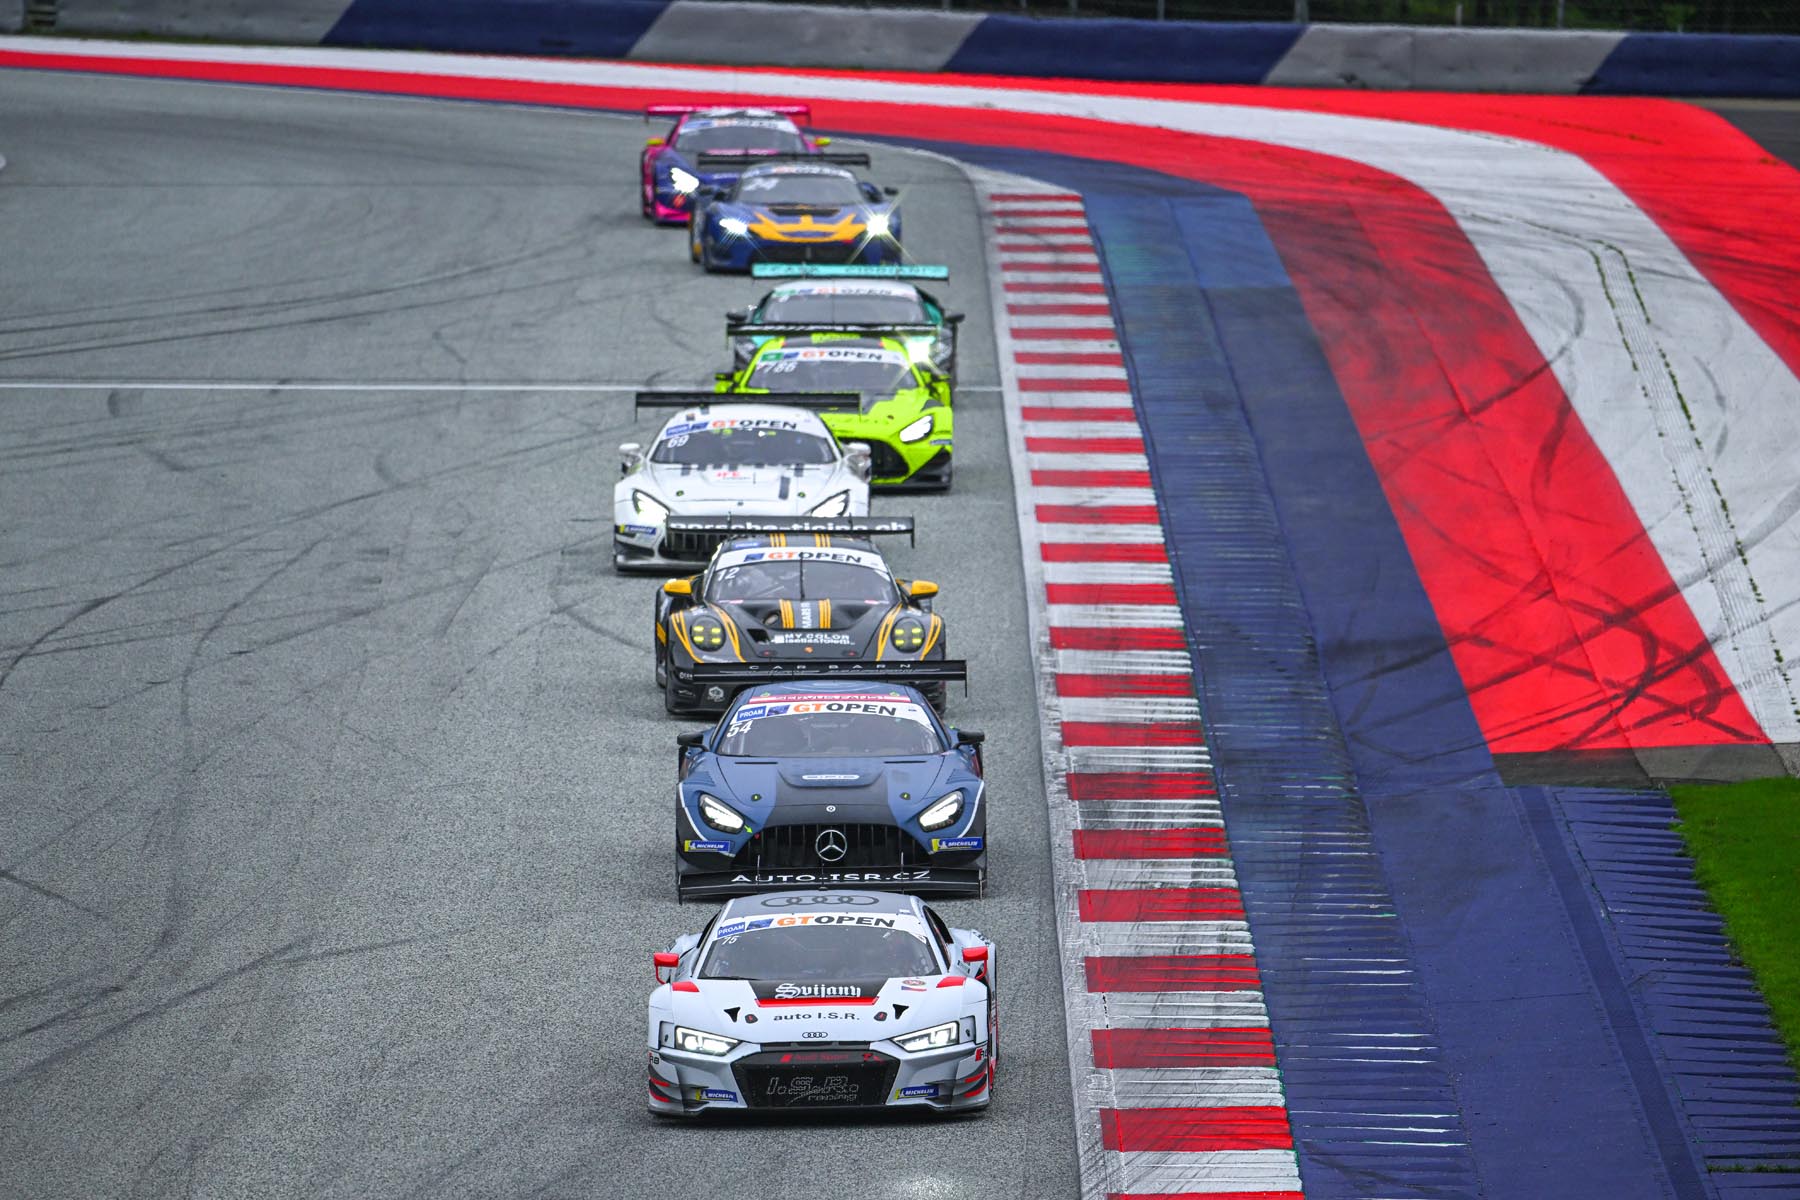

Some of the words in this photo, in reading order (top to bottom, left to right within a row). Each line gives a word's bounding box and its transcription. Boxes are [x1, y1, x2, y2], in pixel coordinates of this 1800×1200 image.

[667, 434, 689, 448] 69
[717, 566, 740, 581] 12
[739, 708, 764, 719] PROAM
[727, 720, 753, 738] 54
[696, 842, 725, 850] MICHELIN
[947, 839, 978, 847] MICHELIN
[731, 870, 931, 882] AUTO-ISR.CZ
[718, 924, 745, 936] PROAM
[721, 935, 741, 945] 75
[773, 1013, 812, 1021] auto
[817, 1012, 860, 1021] I.S.R.
[707, 1091, 734, 1099] MICHELIN
[905, 1088, 935, 1096] MICHELIN
